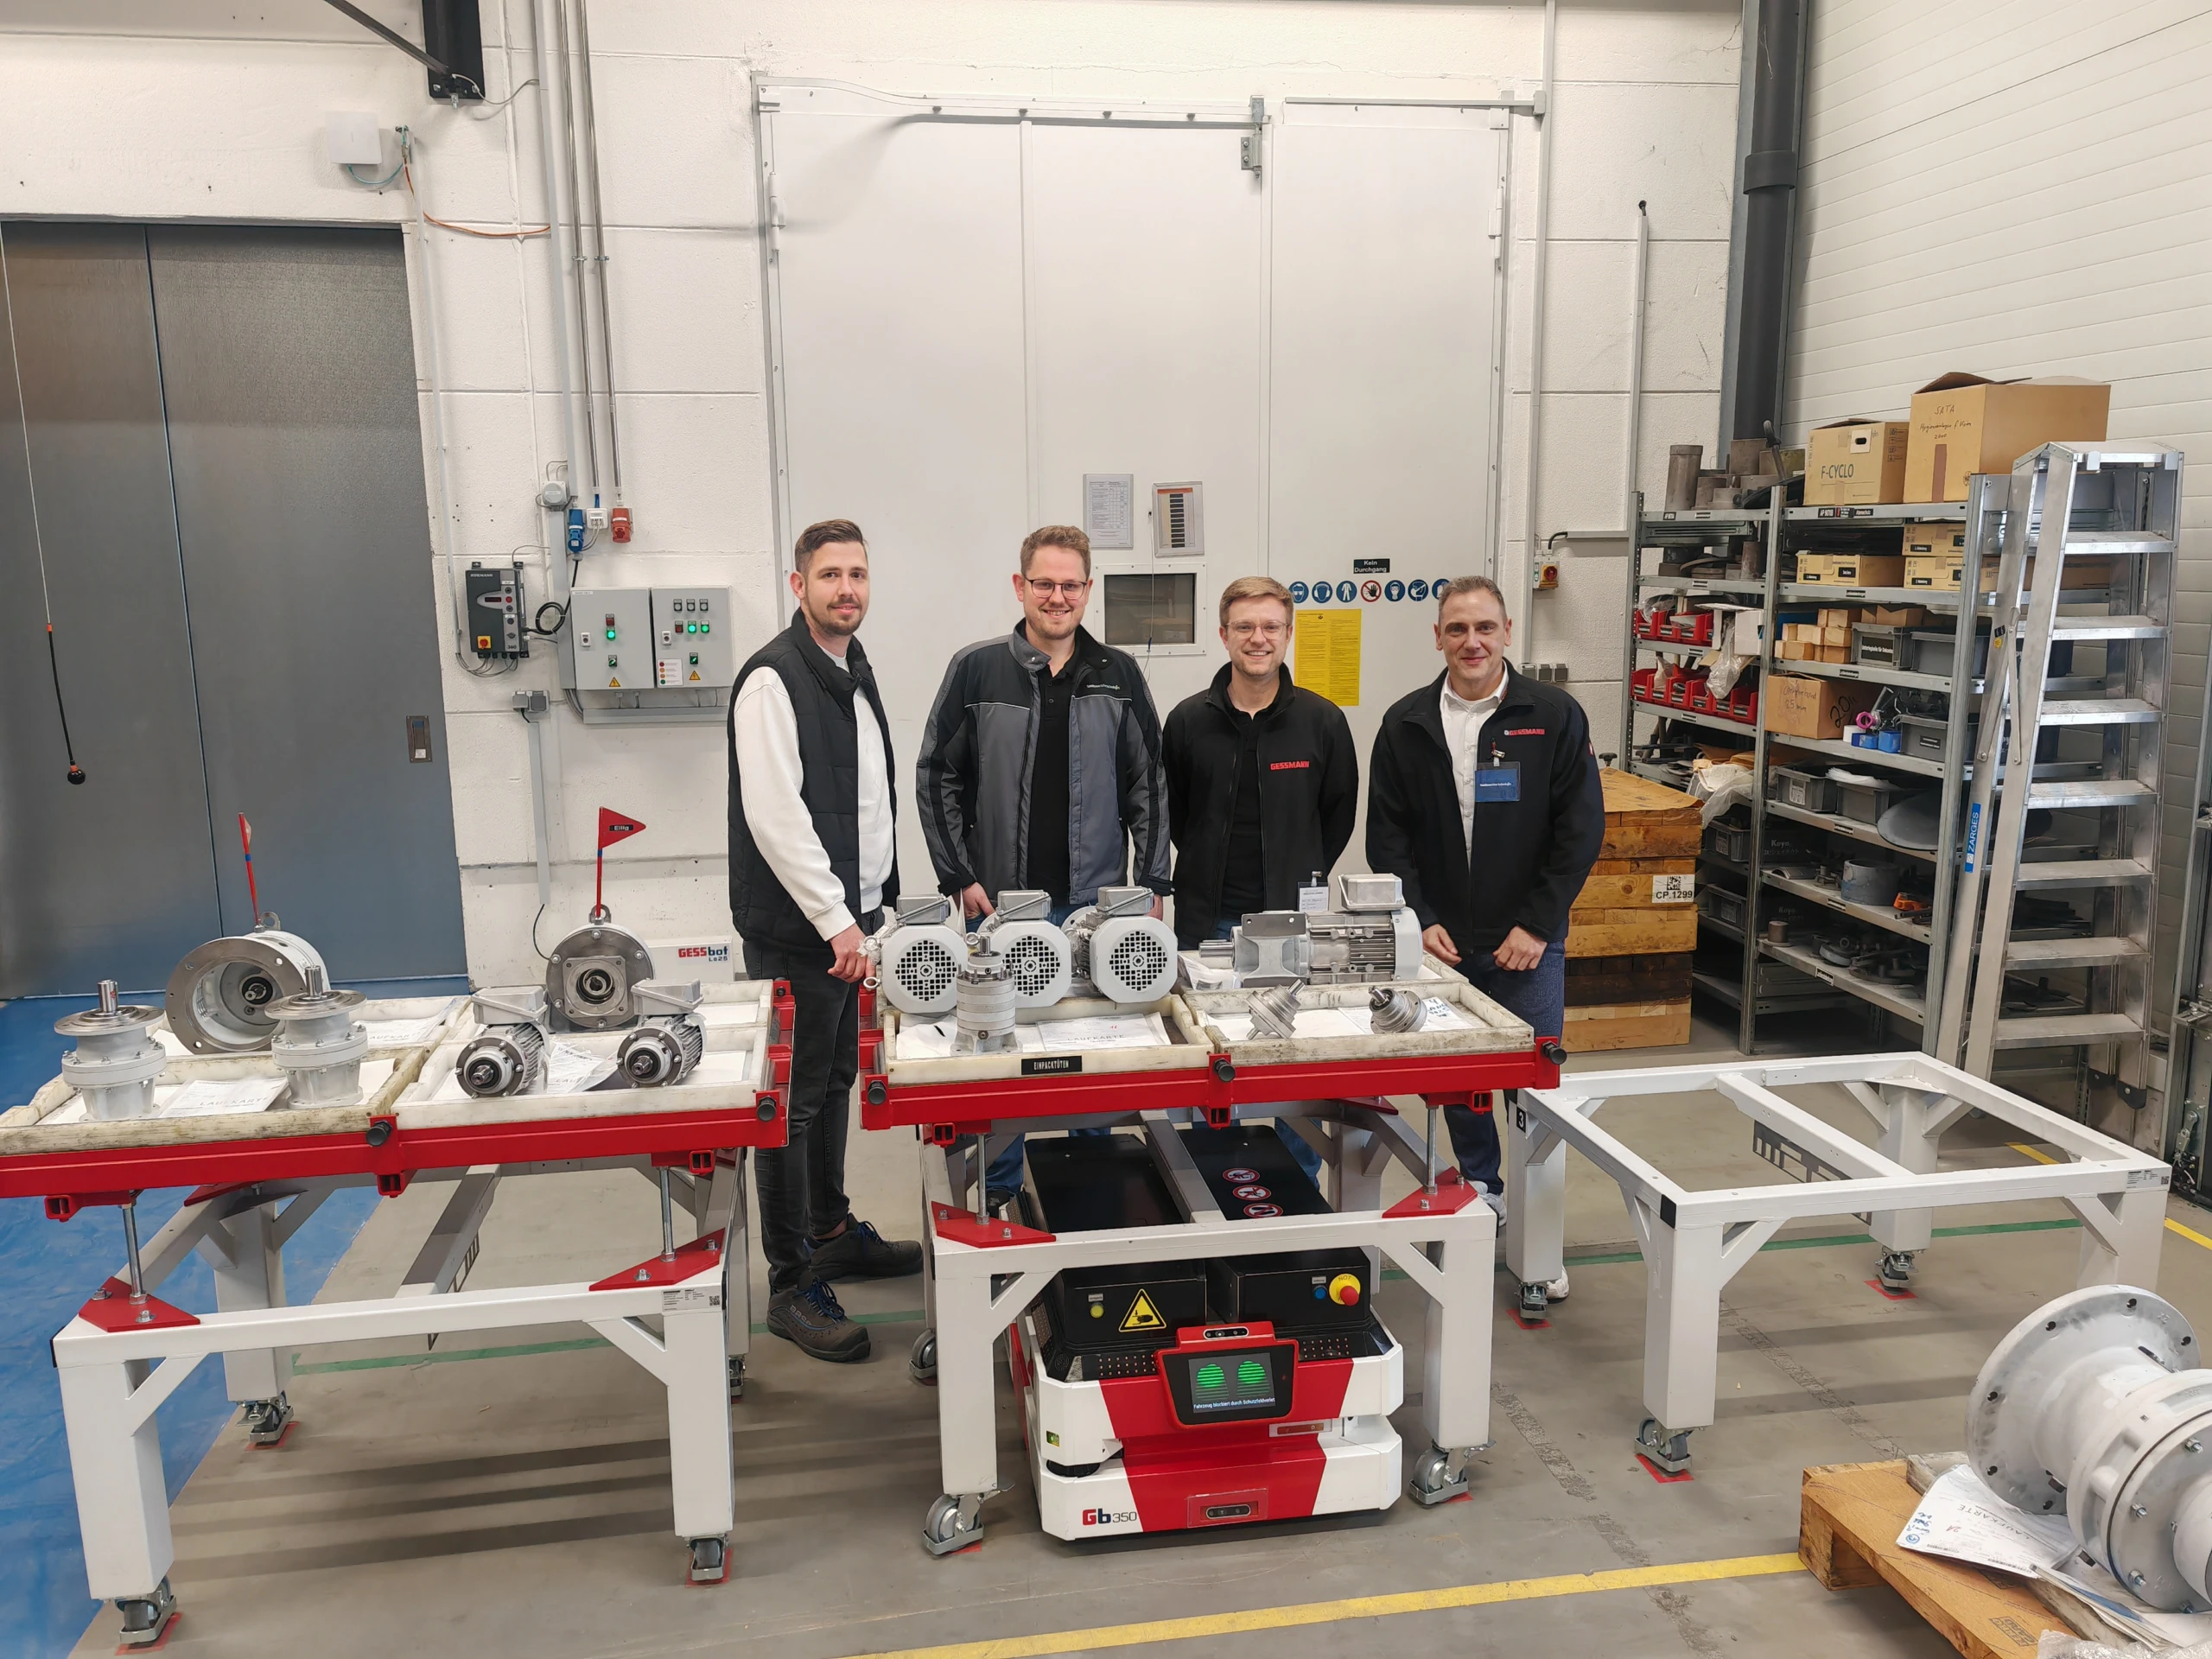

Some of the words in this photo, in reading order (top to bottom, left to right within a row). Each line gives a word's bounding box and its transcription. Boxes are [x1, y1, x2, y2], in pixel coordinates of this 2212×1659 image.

[1934, 404, 1955, 415] SATA
[1821, 463, 1854, 480] F-CYCLO
[1270, 760, 1310, 771] GESSMANN
[1968, 812, 1979, 852] ZARGES
[1771, 839, 1789, 849] Koyo
[1656, 891, 1693, 899] CP.1299
[678, 946, 728, 958] GESSbot
[1518, 1111, 1524, 1128] 3
[1957, 1503, 2031, 1540] LAUFKARTE
